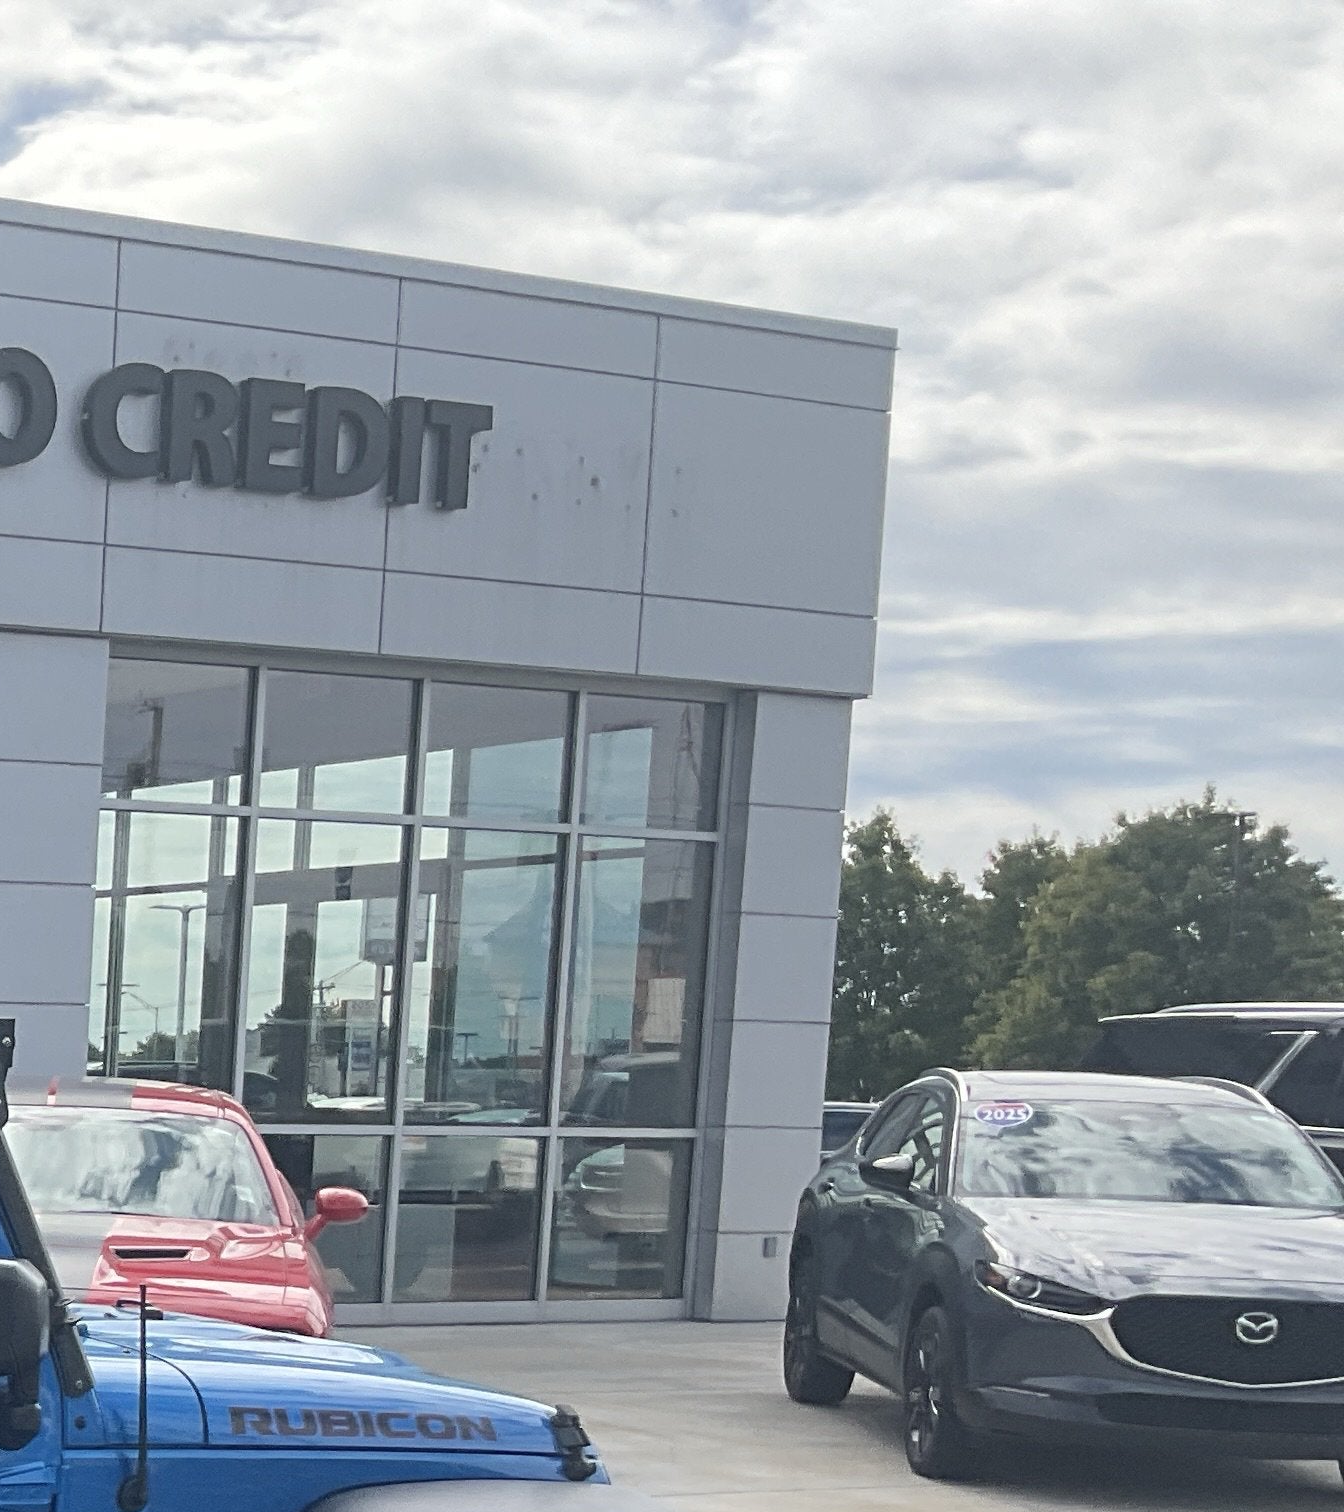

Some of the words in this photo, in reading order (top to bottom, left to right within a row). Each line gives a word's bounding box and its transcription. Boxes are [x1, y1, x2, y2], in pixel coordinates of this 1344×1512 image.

[82, 362, 492, 510] CREDIT
[982, 1107, 1027, 1121] 2025
[229, 1406, 497, 1441] RUBICON
